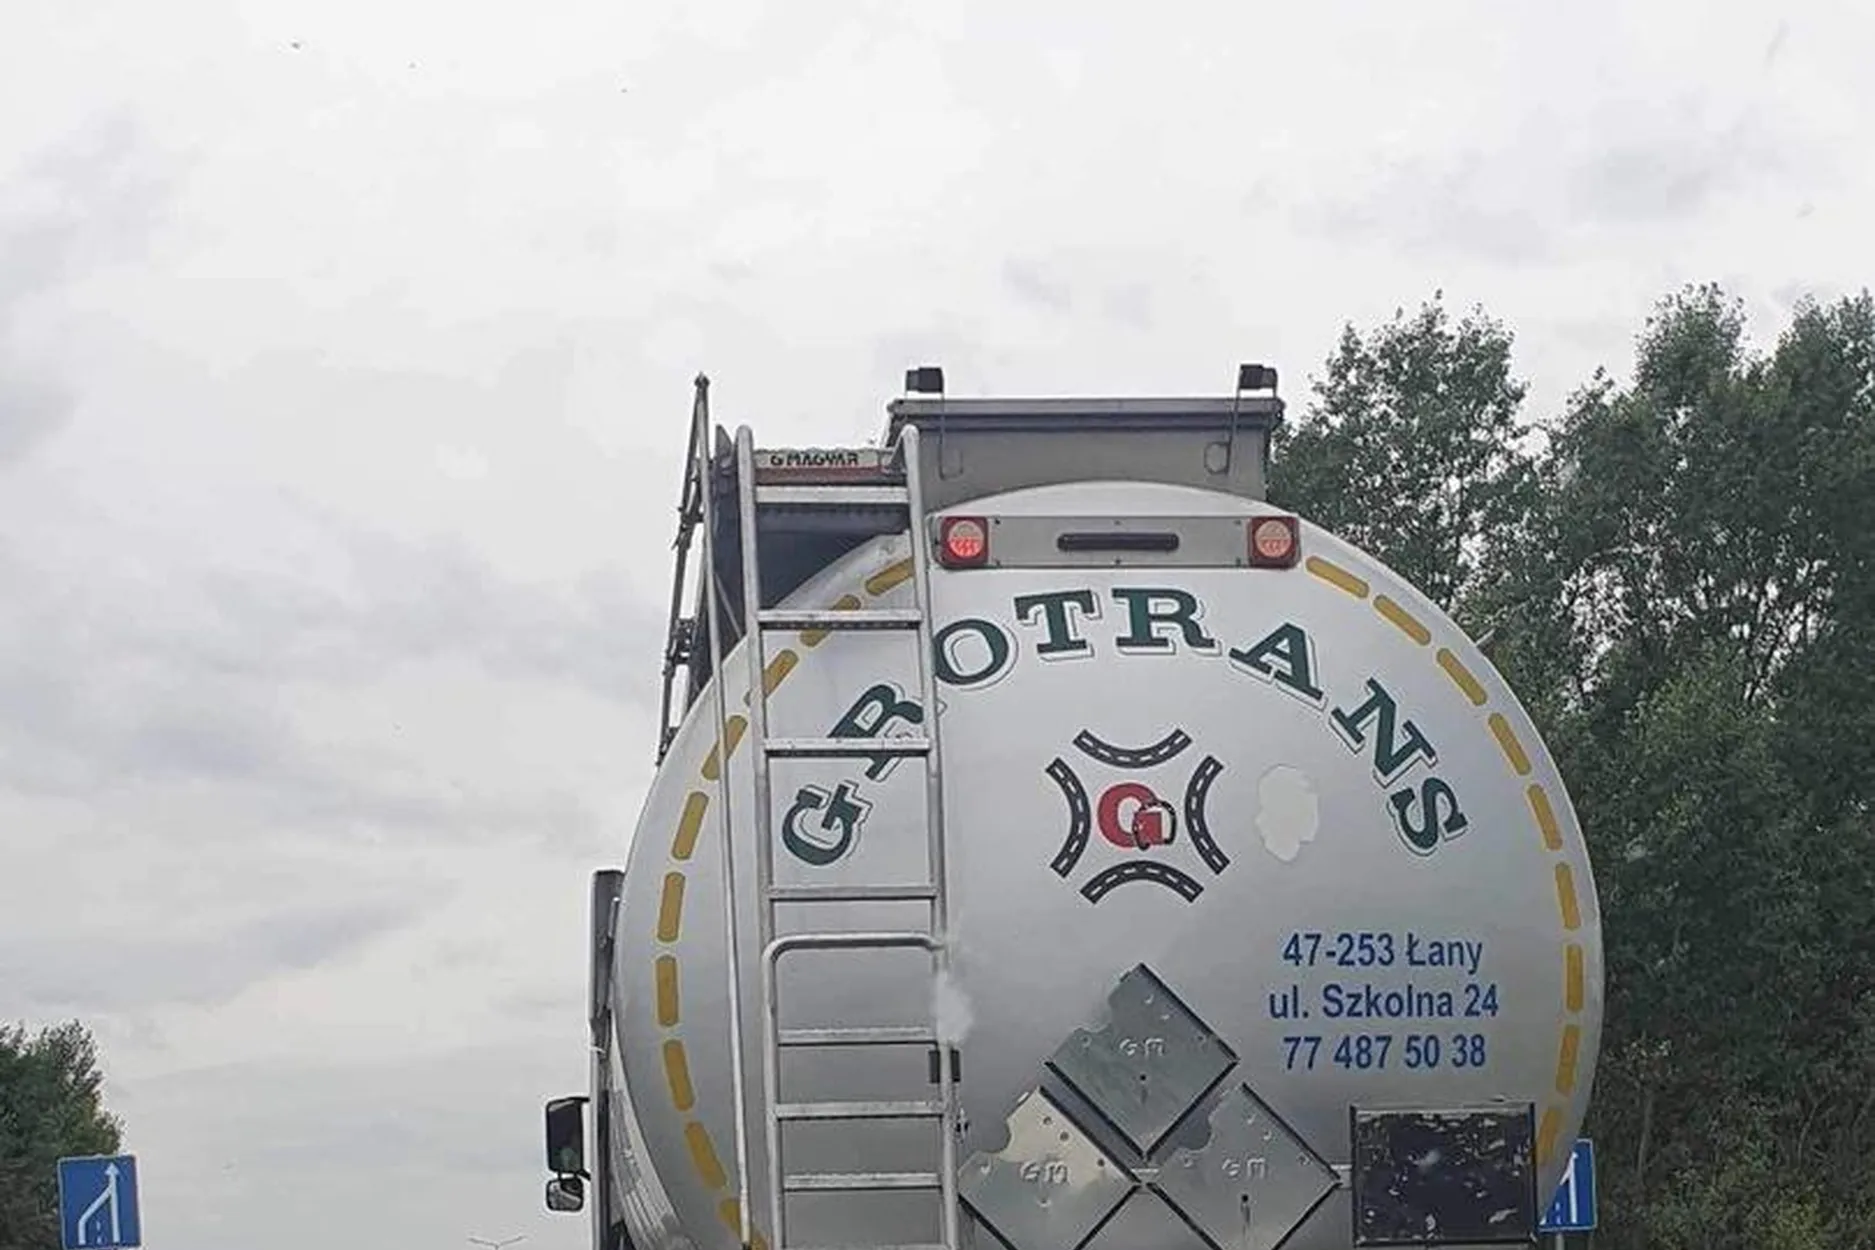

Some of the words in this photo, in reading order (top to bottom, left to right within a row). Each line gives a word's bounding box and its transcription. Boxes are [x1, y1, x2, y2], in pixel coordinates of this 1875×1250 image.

[781, 586, 1469, 866] GROTRANS
[1283, 933, 1395, 966] 47-253
[1406, 932, 1483, 975] Łany
[1269, 985, 1309, 1018] ul.
[1322, 984, 1453, 1018] Szkolna
[1464, 983, 1499, 1017] 24
[1283, 1037, 1322, 1069] 77
[1333, 1035, 1393, 1069] 487
[1404, 1034, 1440, 1068] 50
[1451, 1033, 1485, 1067] 38
